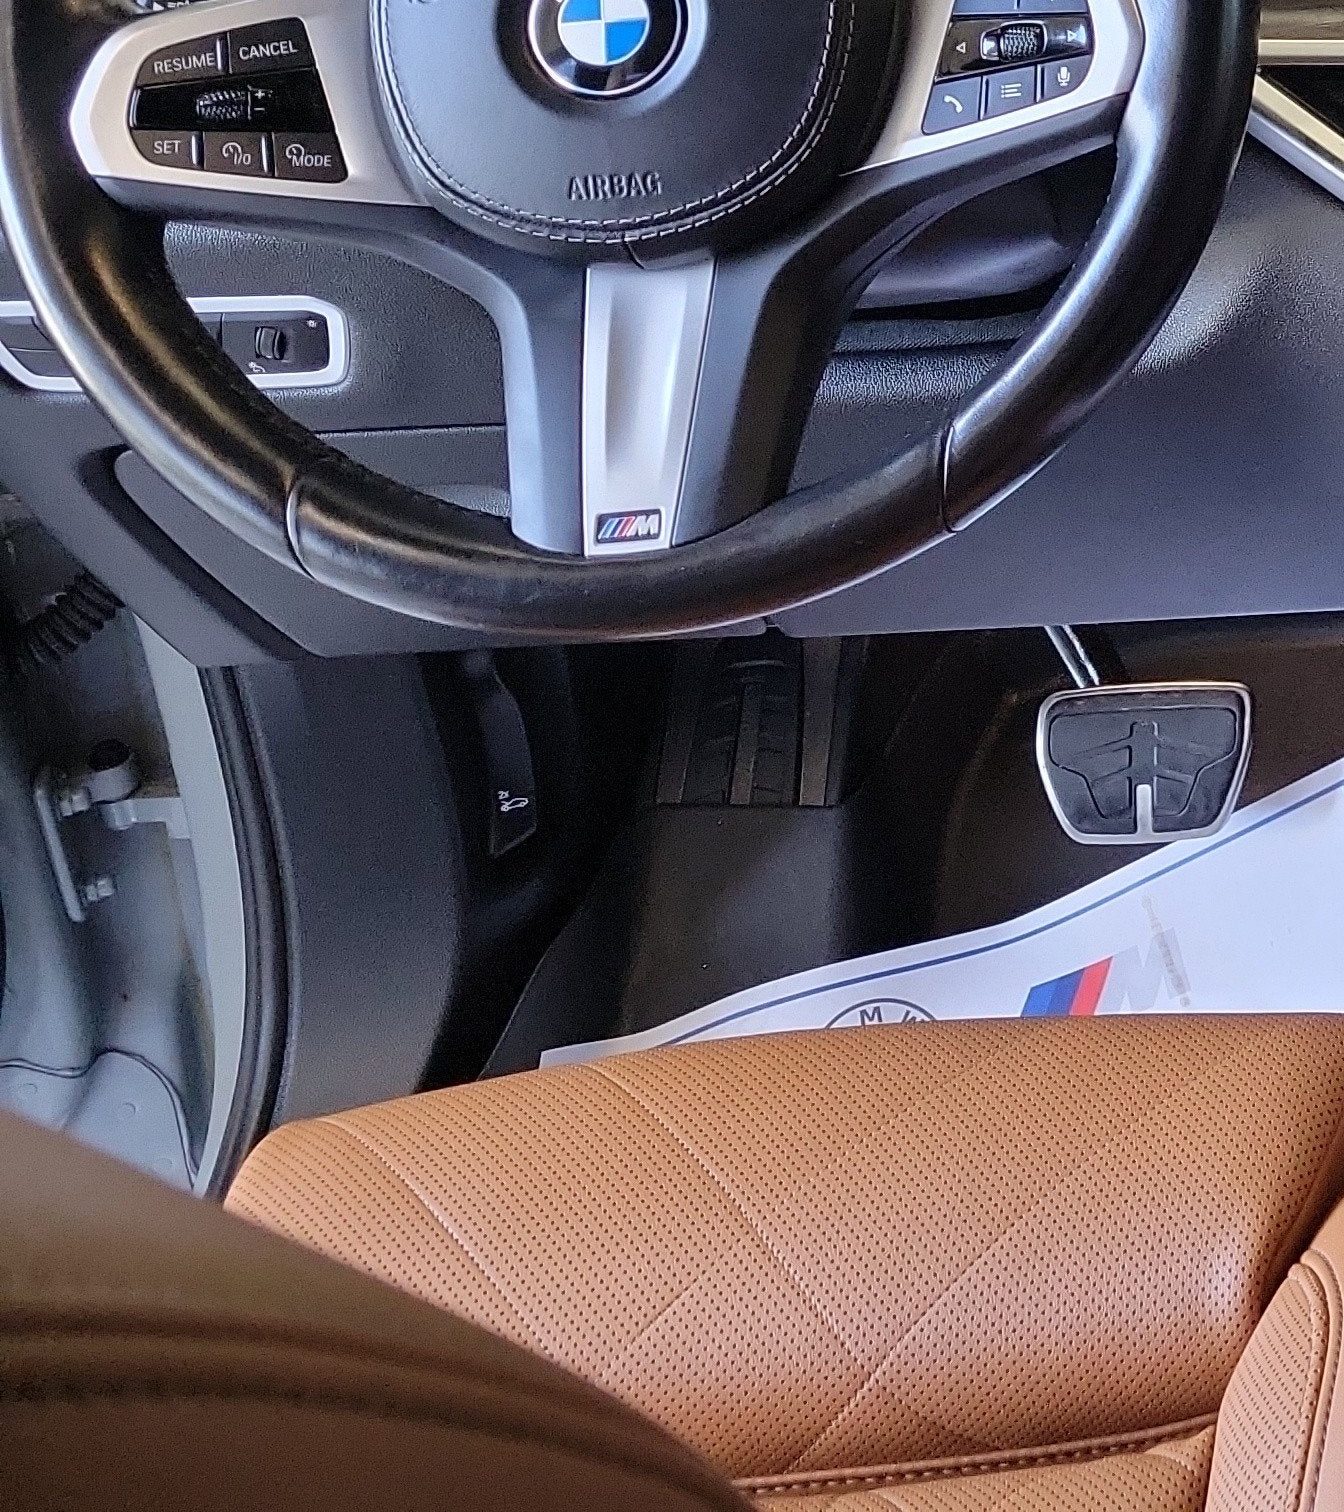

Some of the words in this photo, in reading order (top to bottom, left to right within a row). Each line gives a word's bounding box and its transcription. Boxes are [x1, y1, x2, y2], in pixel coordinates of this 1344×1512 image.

[153, 52, 216, 74] RESUME
[238, 39, 298, 61] CANCEL
[153, 140, 181, 155] SET
[292, 154, 332, 168] MODE
[568, 171, 663, 202] AIRBAG
